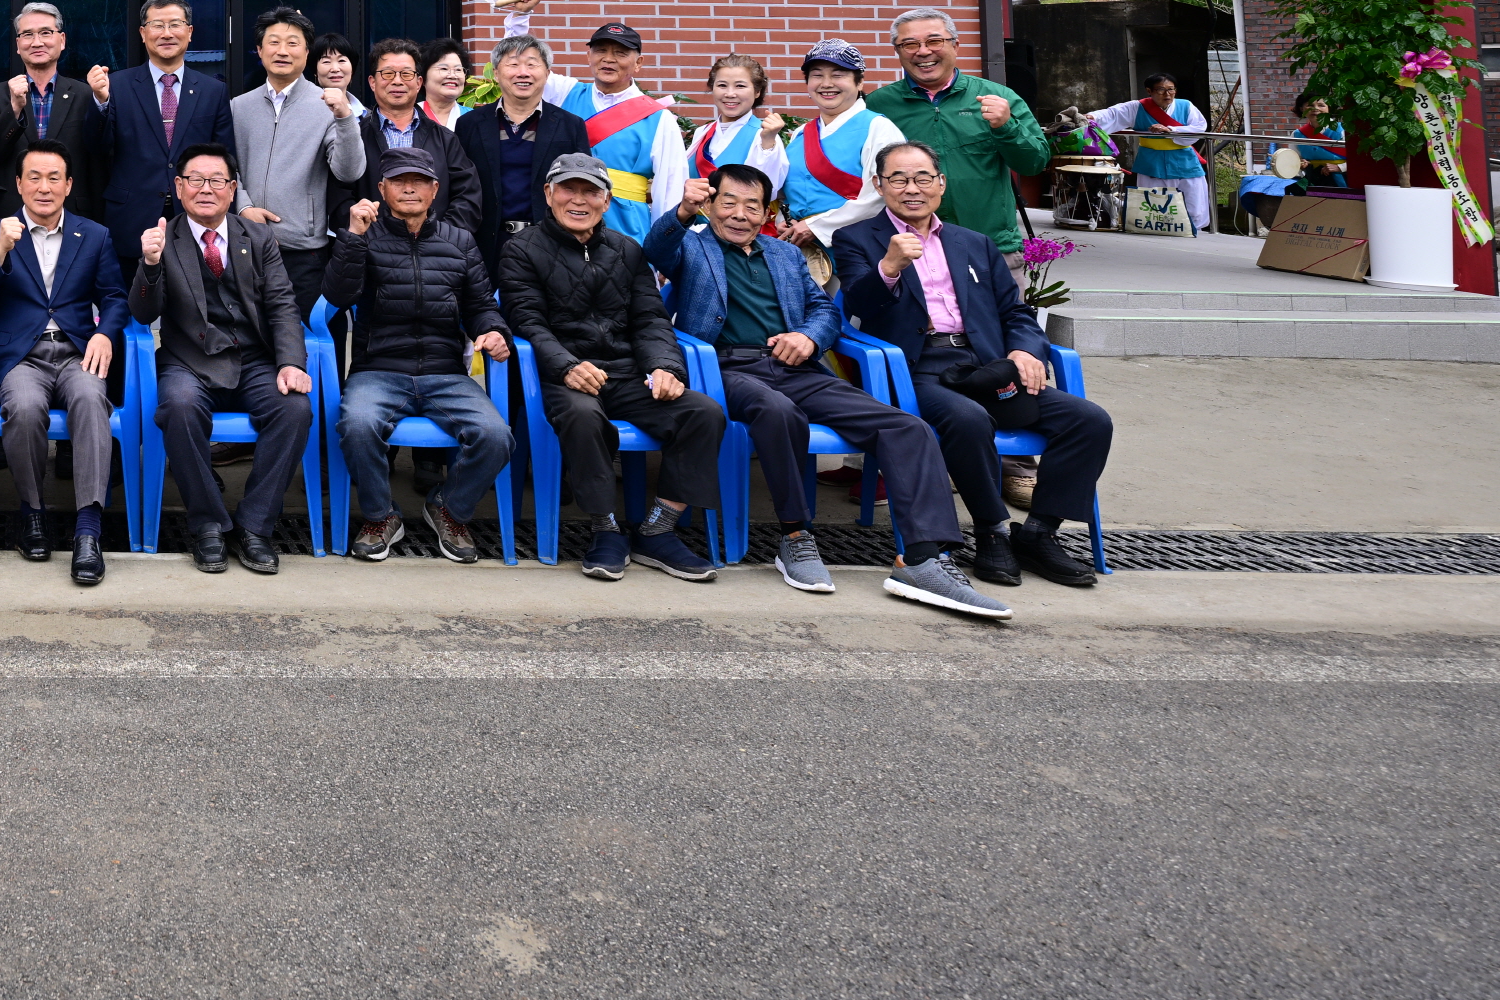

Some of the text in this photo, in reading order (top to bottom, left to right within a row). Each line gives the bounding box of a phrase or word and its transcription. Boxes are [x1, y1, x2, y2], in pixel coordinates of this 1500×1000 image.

[1140, 201, 1178, 214] SAVE
[1148, 213, 1163, 222] THE
[1135, 219, 1184, 232] EARTH
[1290, 223, 1308, 234] 전자
[1285, 238, 1313, 248] DIGITAL
[1316, 242, 1341, 251] CLOCK
